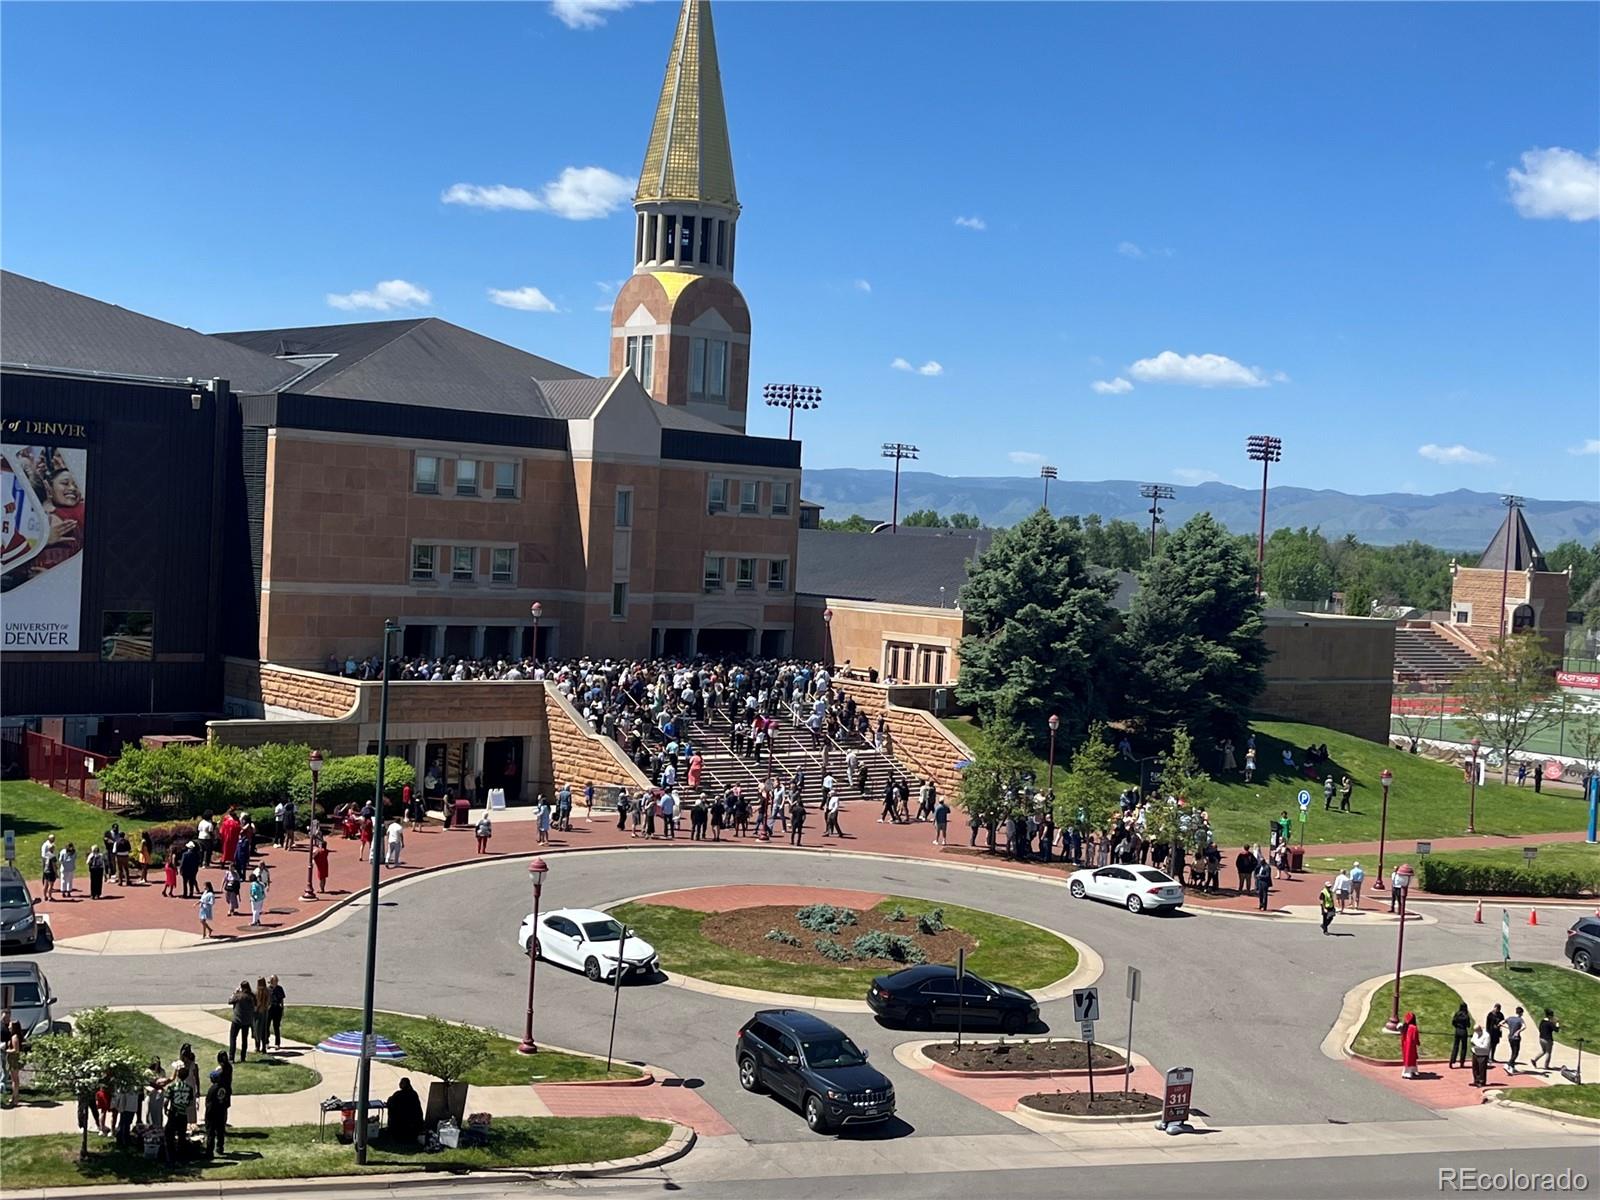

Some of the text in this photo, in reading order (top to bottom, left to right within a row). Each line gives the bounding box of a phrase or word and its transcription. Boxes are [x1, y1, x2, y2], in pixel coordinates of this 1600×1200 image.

[8, 420, 21, 432] of
[26, 421, 86, 437] DENVER
[5, 623, 60, 631] UNIVERSITY
[5, 631, 69, 645] DENVER
[1557, 672, 1599, 683] FASTSIGNS
[1301, 793, 1308, 803] P
[1169, 1093, 1187, 1105] 311
